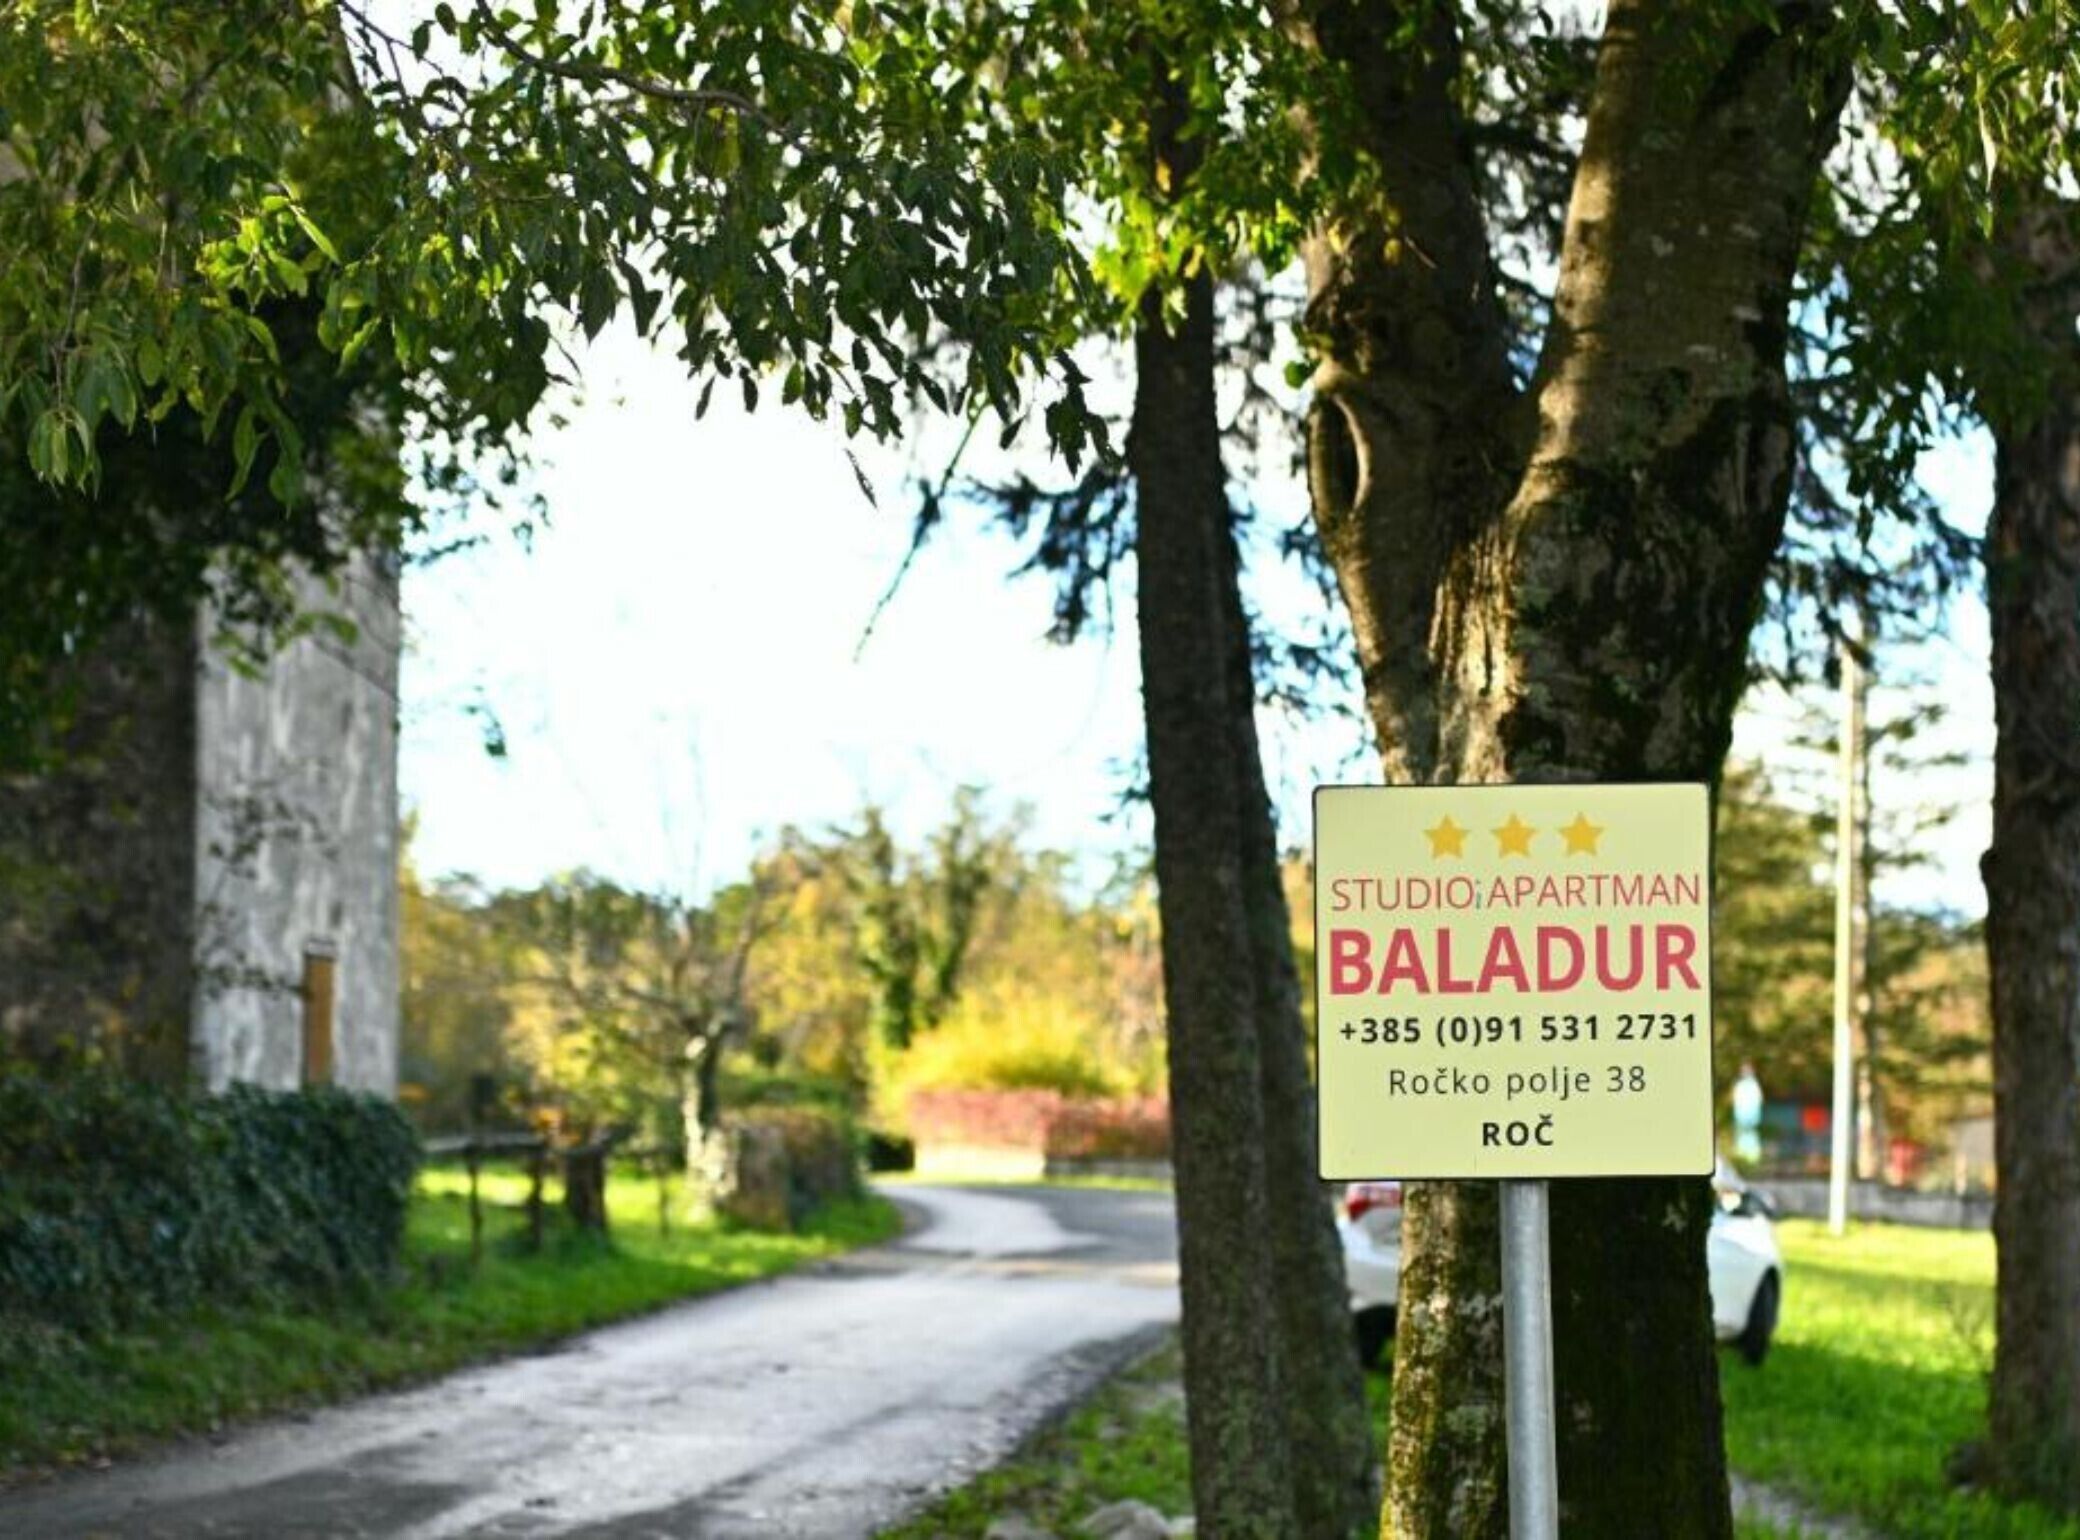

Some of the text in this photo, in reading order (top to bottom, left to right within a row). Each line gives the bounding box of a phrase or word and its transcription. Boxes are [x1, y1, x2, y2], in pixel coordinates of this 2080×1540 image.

[1330, 877, 1475, 911] STUDIO
[1486, 874, 1700, 908] APARTMAN
[1329, 924, 1701, 995] BALADUR
[1340, 1014, 1696, 1047] +385 (0)91 531 2731
[1389, 1066, 1646, 1100] Ročko polje 38
[1481, 1114, 1554, 1146] ROČ
